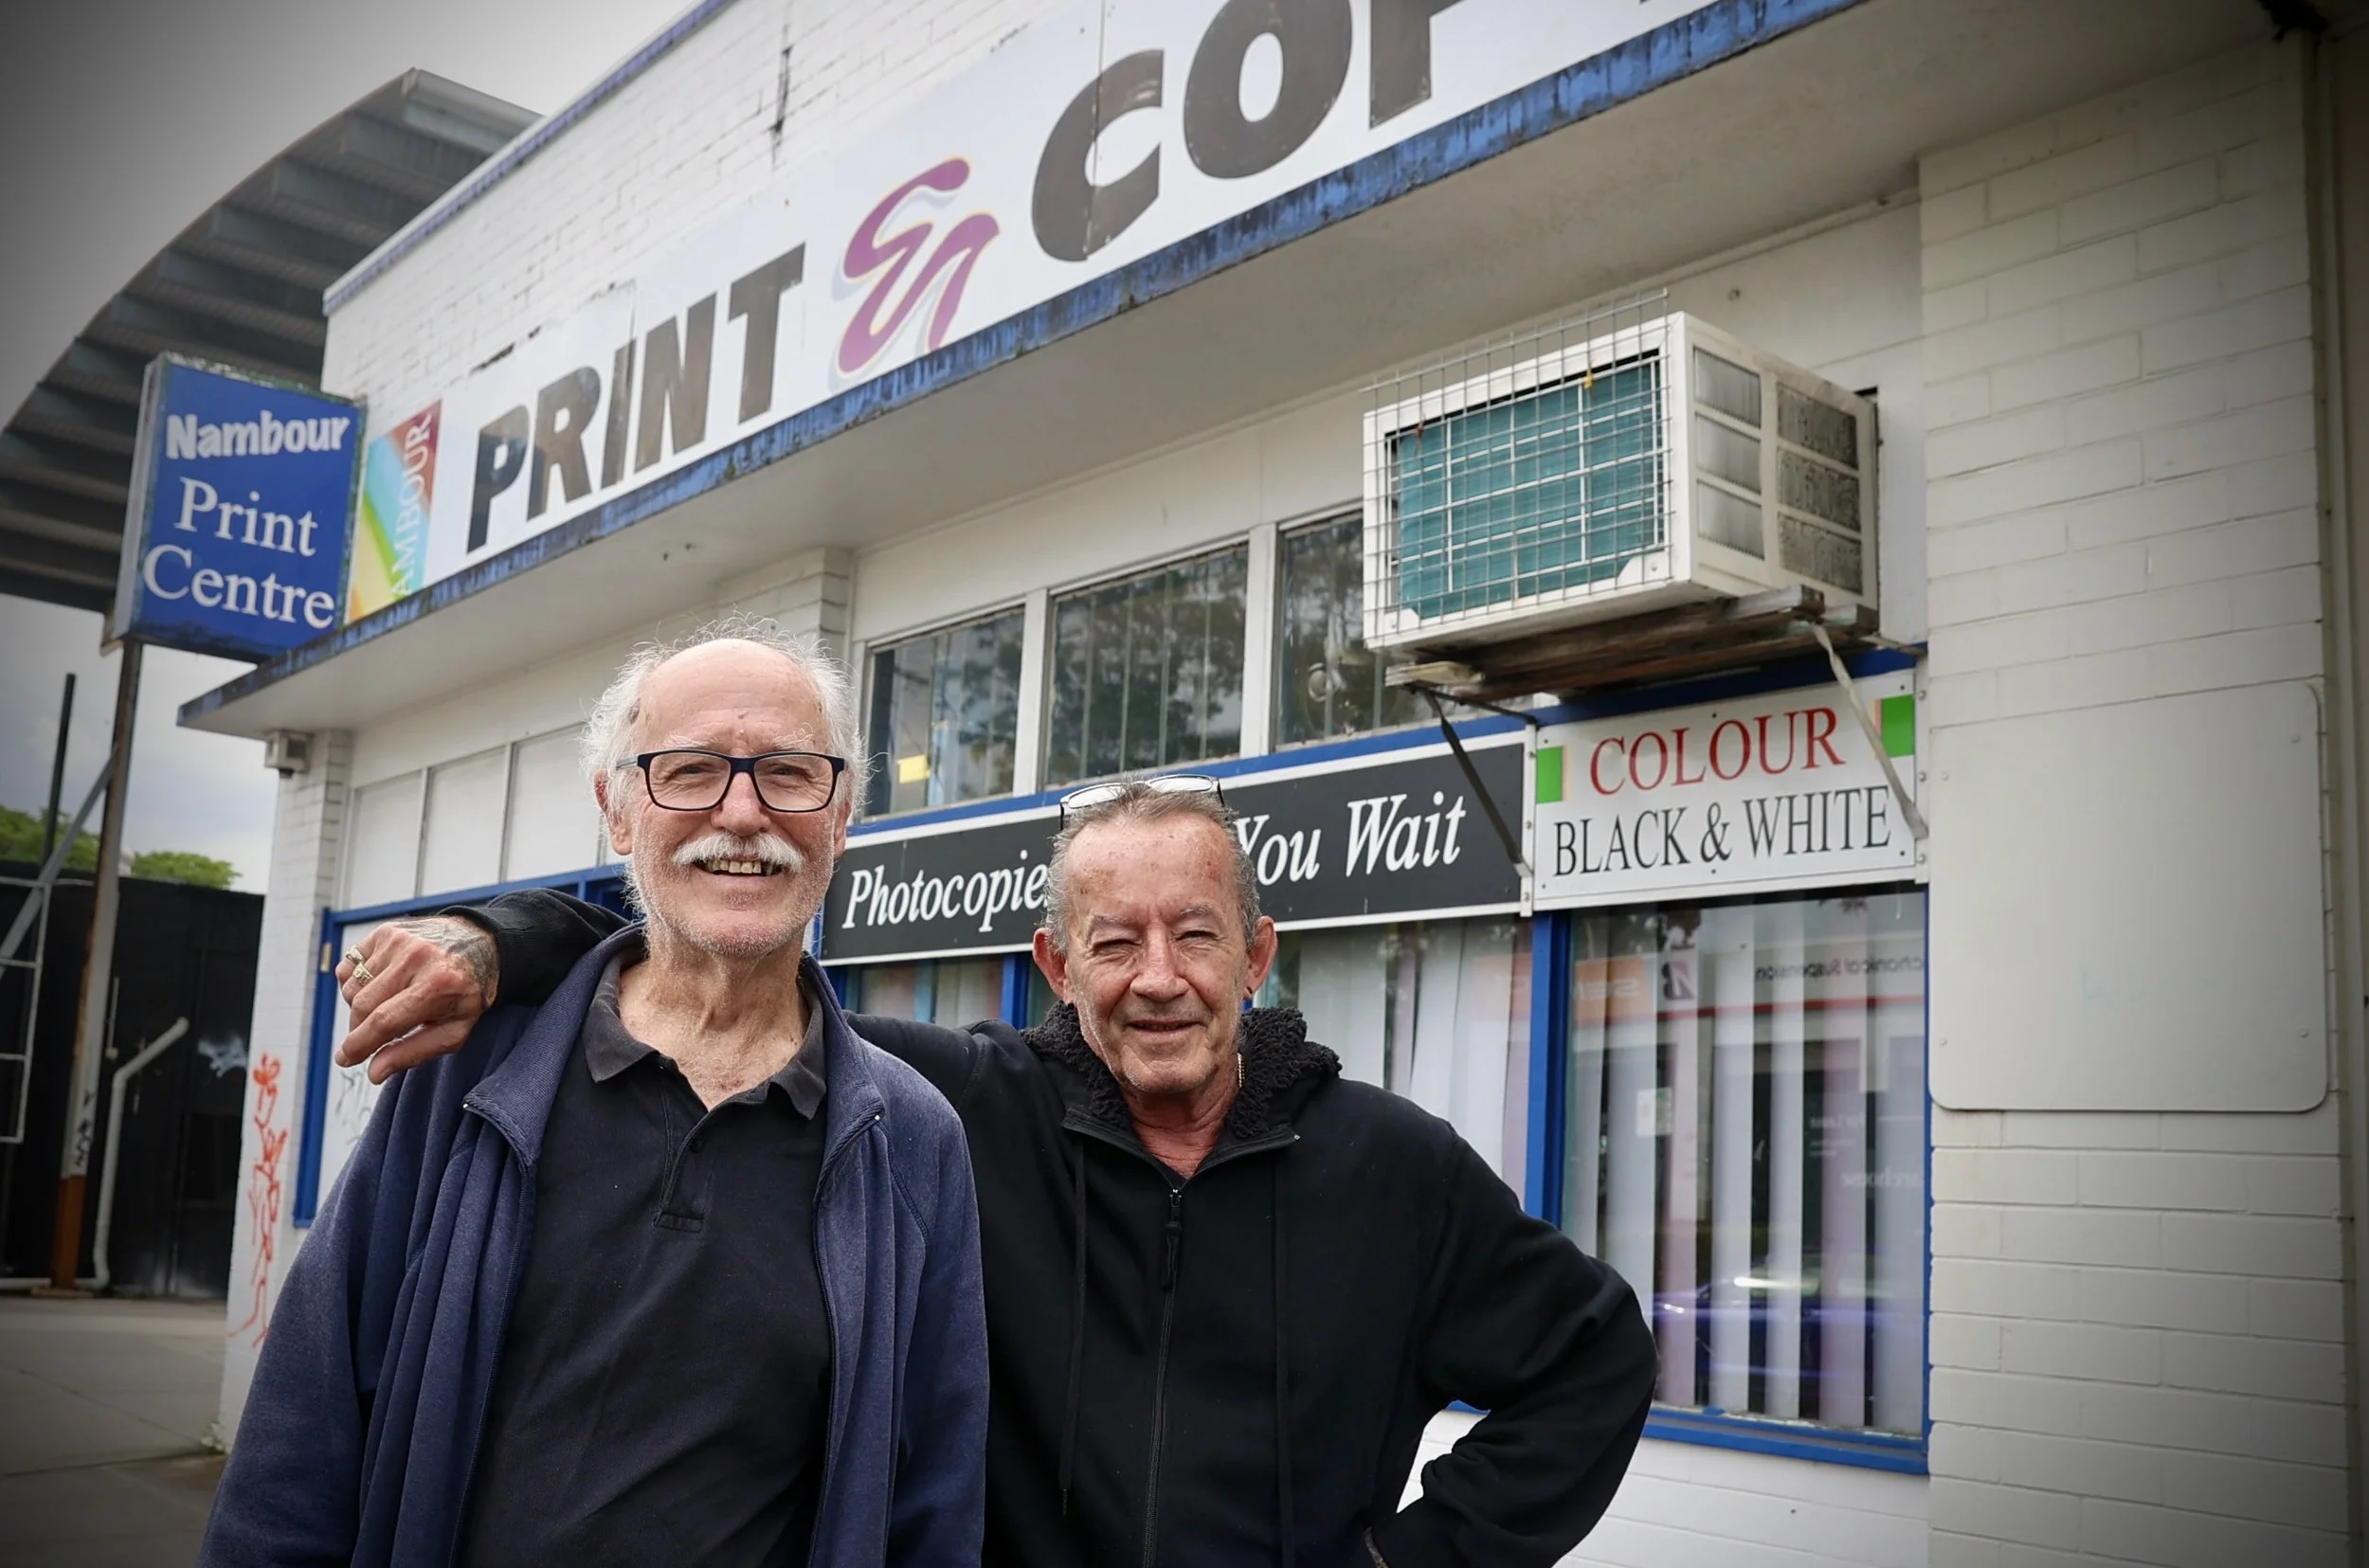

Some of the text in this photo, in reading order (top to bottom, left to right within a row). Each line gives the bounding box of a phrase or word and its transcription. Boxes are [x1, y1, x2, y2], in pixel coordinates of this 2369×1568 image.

[166, 409, 352, 460] Nambour
[466, 243, 805, 554] PRINT
[173, 477, 318, 557] Print
[390, 412, 432, 595] AMBOUR
[142, 544, 335, 630] Centre
[1589, 707, 1846, 796] COLOUR
[842, 850, 1050, 932] Photocopie
[1347, 791, 1467, 877] Wait
[1553, 785, 1891, 876] BLACK & WHITE
